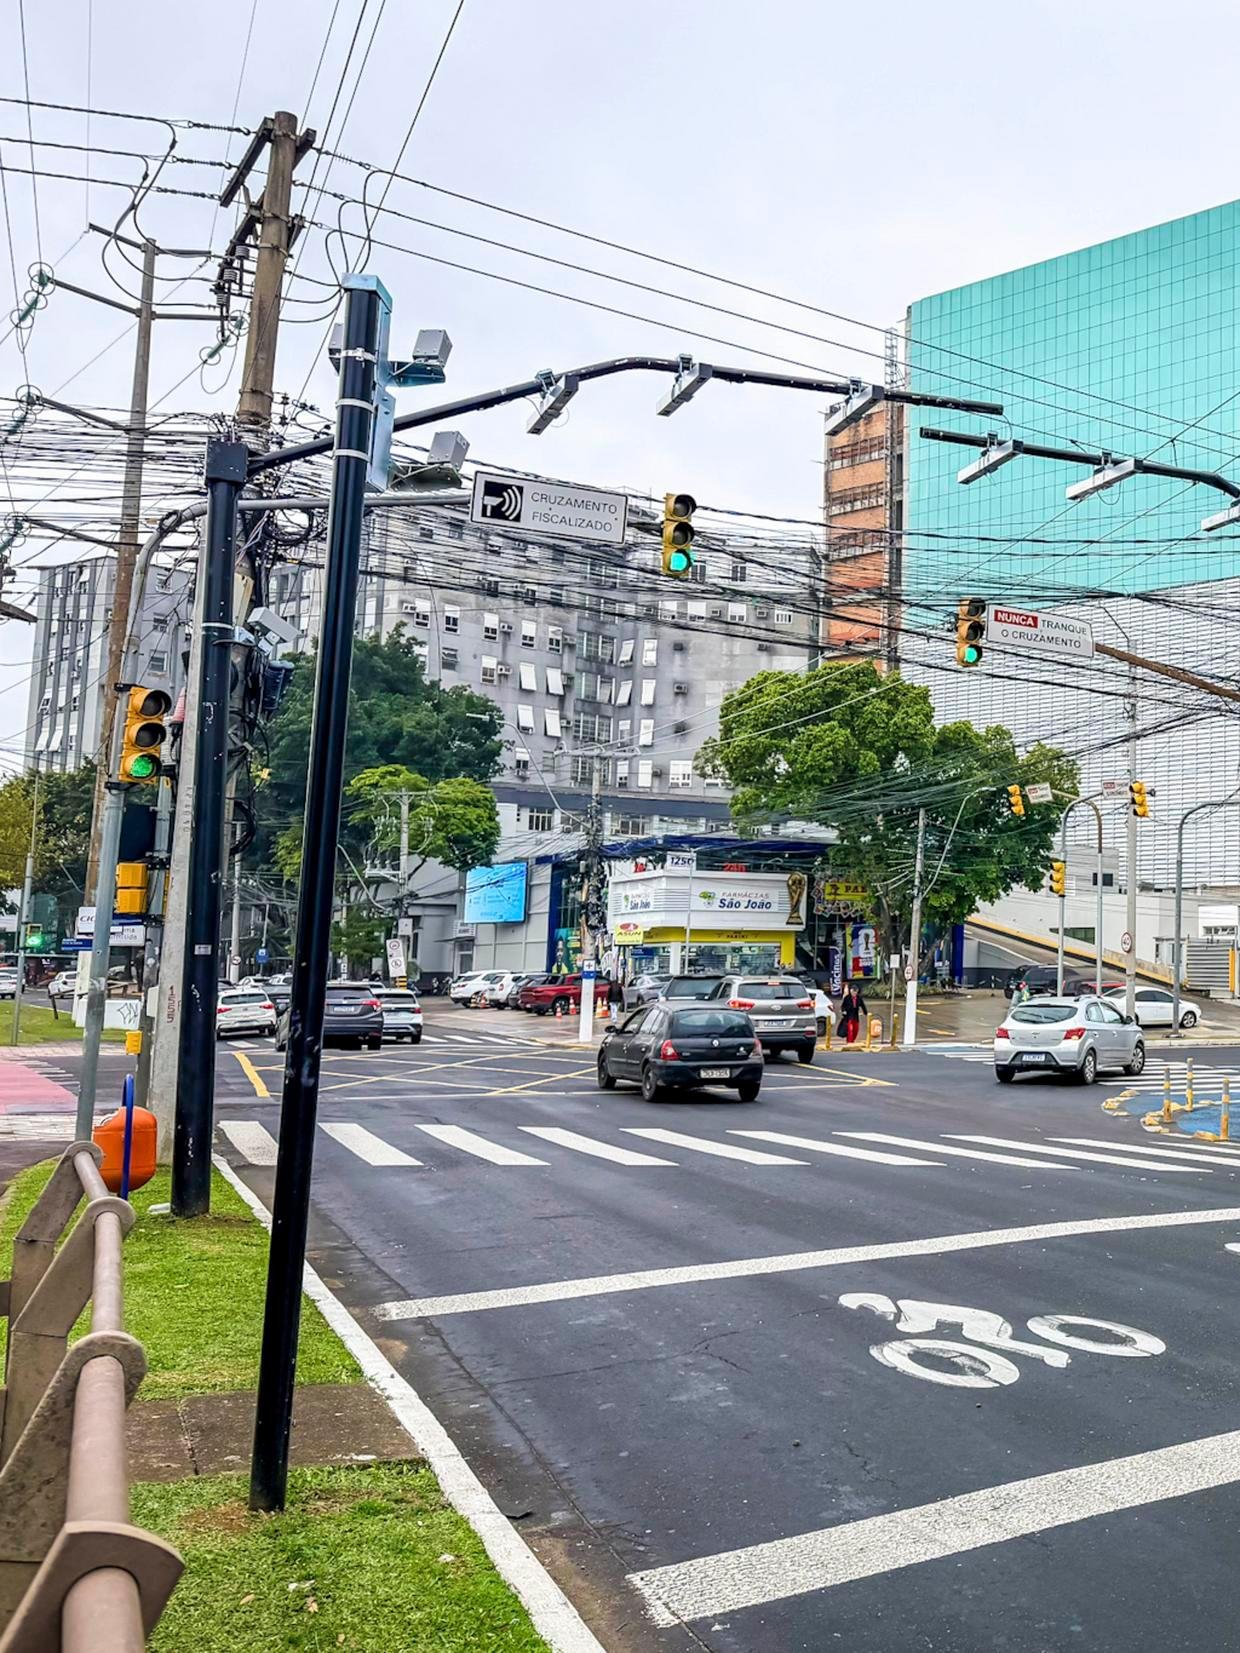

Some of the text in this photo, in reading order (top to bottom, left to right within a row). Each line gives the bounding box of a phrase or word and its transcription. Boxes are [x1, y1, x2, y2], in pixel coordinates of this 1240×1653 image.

[531, 491, 617, 514] CRUZAMENTO
[532, 511, 612, 532] FISCALIZADO
[997, 611, 1087, 635] NUNCA TRANQUE
[1001, 629, 1081, 648] O CRUZAMENTO
[718, 898, 772, 910] São João
